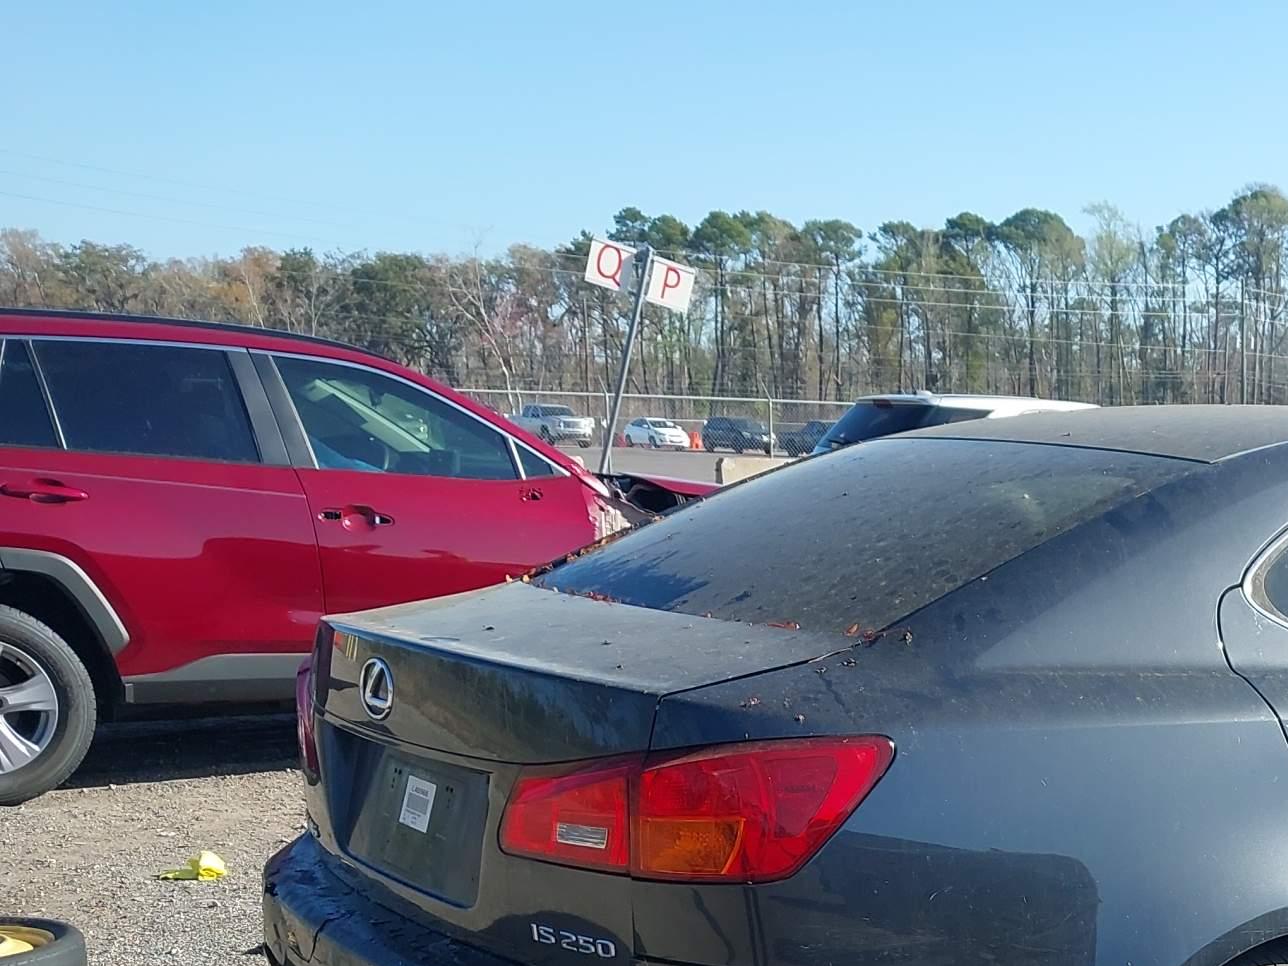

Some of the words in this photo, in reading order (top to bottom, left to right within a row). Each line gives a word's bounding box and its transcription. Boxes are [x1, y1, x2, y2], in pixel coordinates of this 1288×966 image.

[596, 243, 621, 287] Q
[660, 266, 681, 299] P
[530, 923, 556, 944] IS
[559, 931, 616, 957] 250
